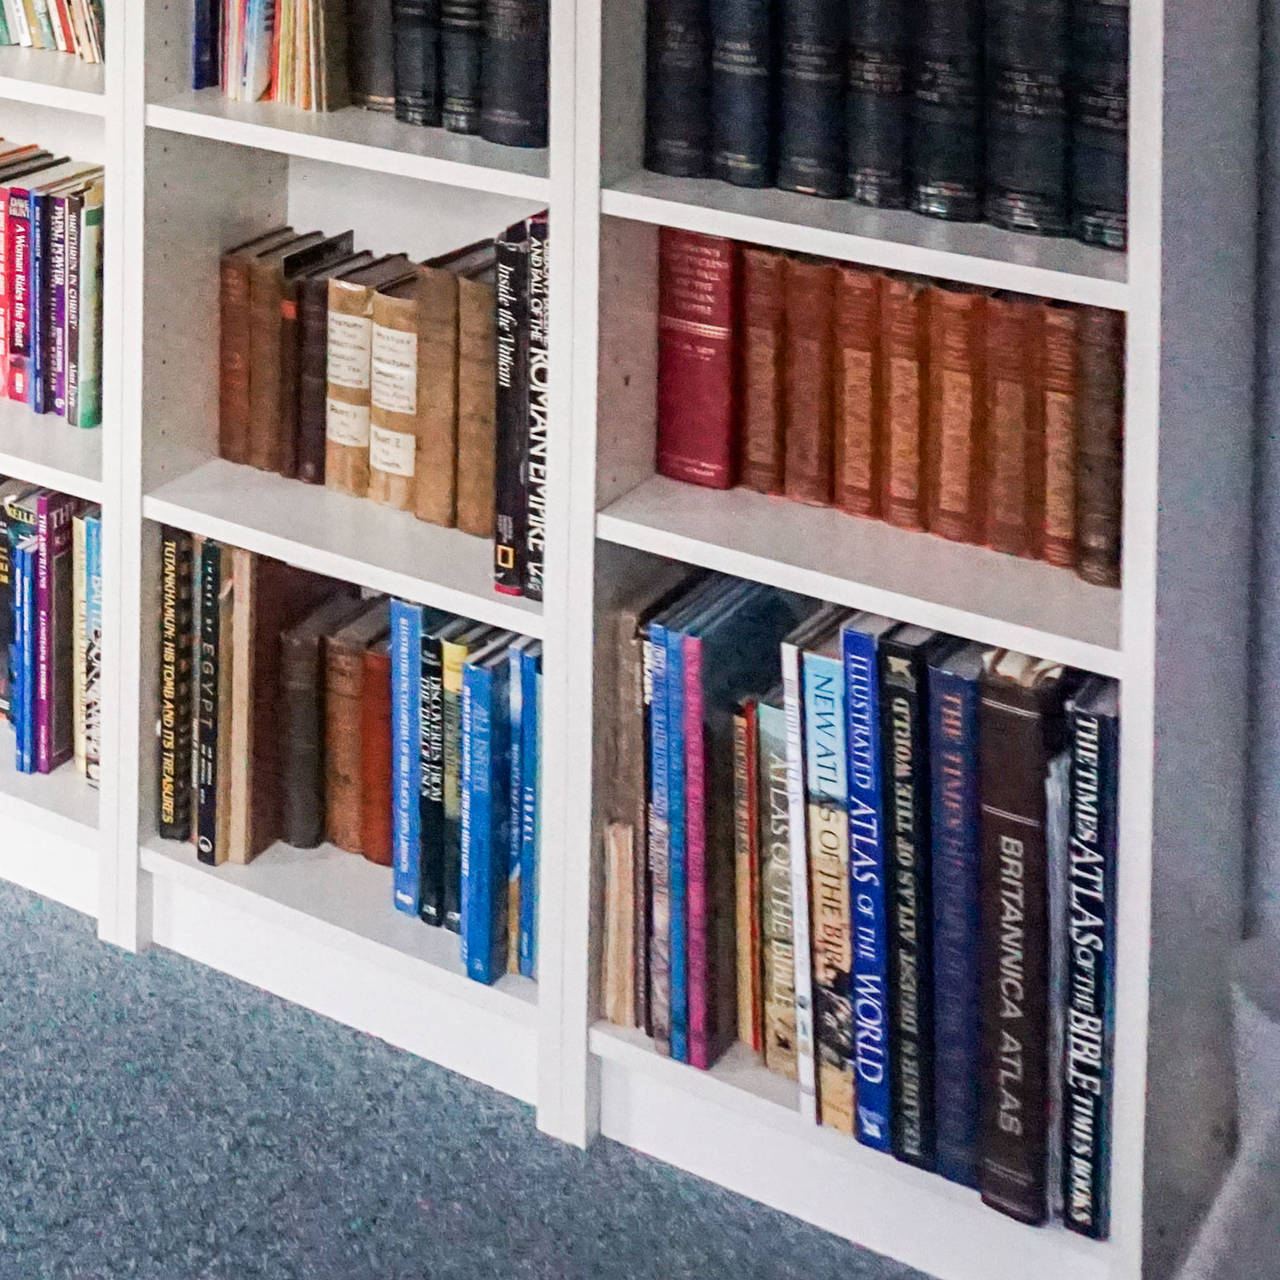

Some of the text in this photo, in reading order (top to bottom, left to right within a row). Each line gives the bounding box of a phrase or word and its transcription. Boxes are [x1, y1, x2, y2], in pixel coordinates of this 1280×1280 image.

[55, 206, 65, 285] PAPAL POWER
[69, 275, 77, 287] IN
[530, 237, 543, 267] AND
[530, 267, 544, 295] FALL
[15, 224, 26, 349] A Woman Rides the Beast
[499, 263, 517, 388] Inside the Vatican
[530, 297, 544, 314] OF
[530, 315, 544, 342] THE
[68, 363, 77, 384] Alan
[529, 347, 548, 458] ROMAN
[39, 514, 47, 532] THE
[528, 460, 548, 552] EMPIRE
[161, 540, 178, 823] TUTANKHAMUN: HIS TOMB AND ITS TREASURES
[201, 642, 215, 730] EGYPT
[943, 693, 963, 742] THE
[430, 676, 442, 802] DISCOVERIES FROM
[893, 698, 912, 777] WORLD
[523, 786, 534, 842] ISRAEL
[814, 673, 842, 919] NEW ATLAS OF THE
[896, 782, 914, 831] THE
[942, 753, 963, 830] TIMES
[770, 752, 792, 1008] ATLAS OF THE BIBLE
[847, 653, 883, 1083] ILLUSTRATED ATLAS OF THE WORLD
[897, 835, 914, 867] OF
[898, 872, 917, 945] ATLAS
[998, 835, 1024, 1136] BRITANNICA ATLAS
[1065, 716, 1104, 1222] THE TIMES ATLAS OF THE BIBLE TIMES BOOKS
